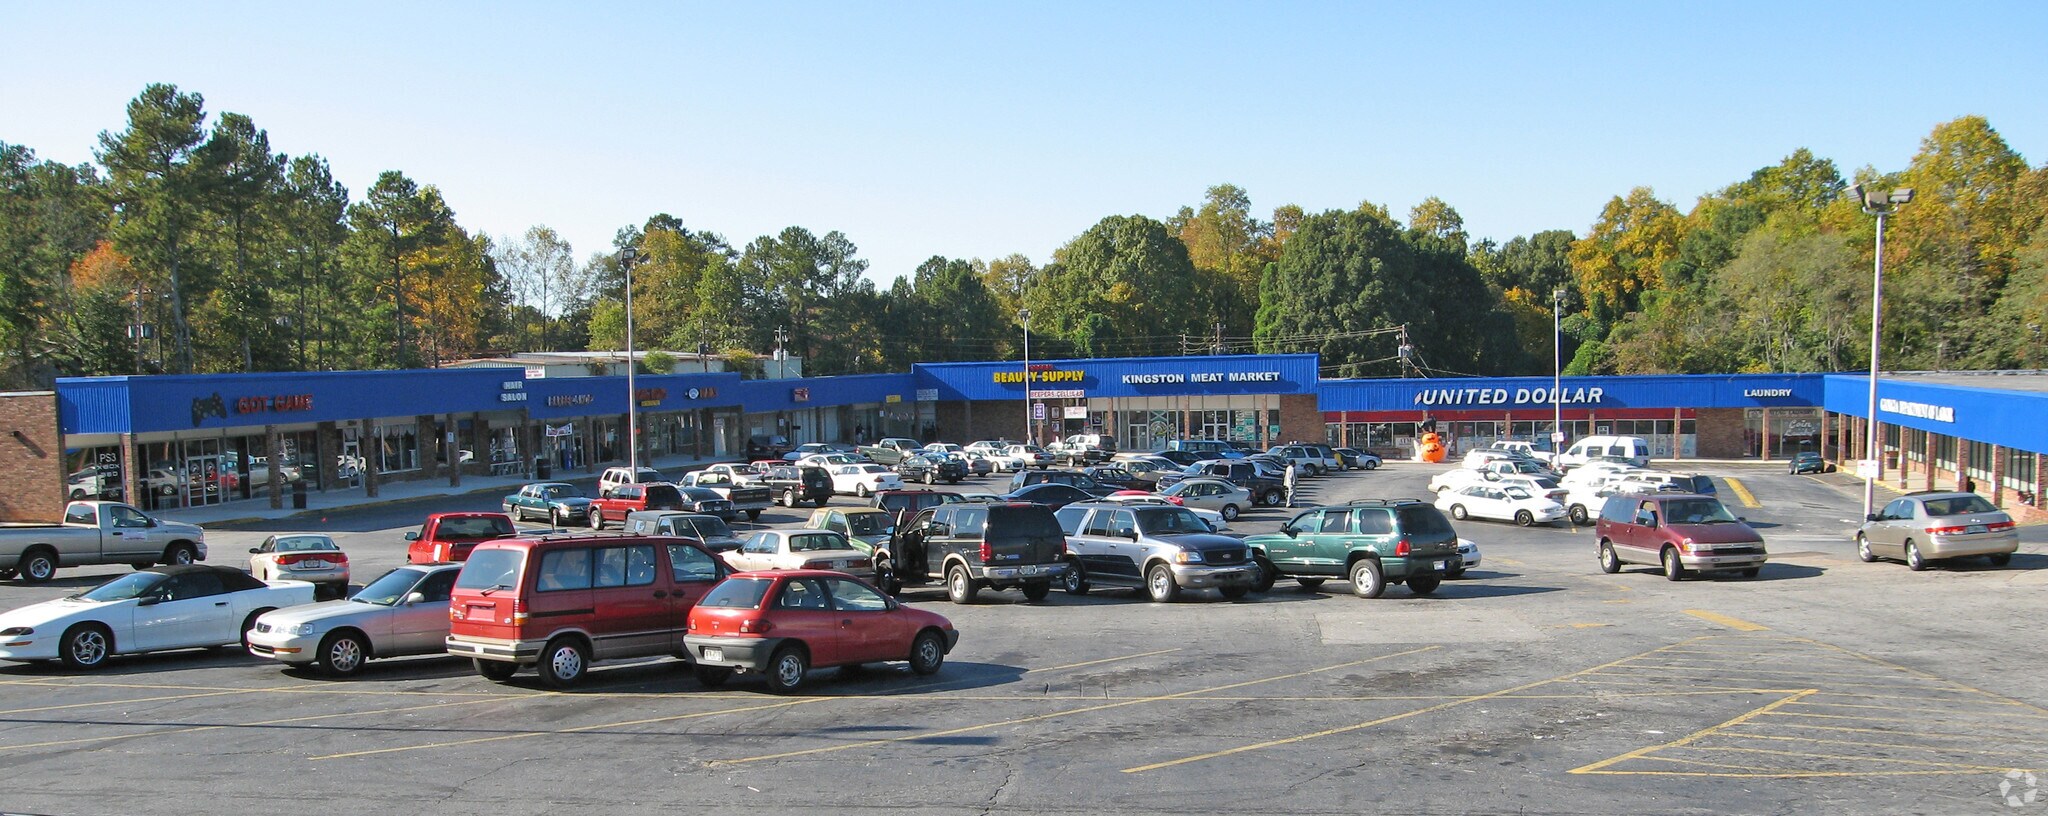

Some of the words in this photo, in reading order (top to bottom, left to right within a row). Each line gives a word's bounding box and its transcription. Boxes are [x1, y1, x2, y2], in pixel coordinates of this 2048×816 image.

[1041, 370, 1085, 382] SUPPLY
[1122, 374, 1184, 383] KINGSTON
[1191, 373, 1224, 382] MEAT
[1229, 372, 1280, 381] MARKET
[503, 381, 523, 390] HAIR
[500, 393, 527, 402] SALON
[1422, 388, 1508, 405] UNITED
[1514, 387, 1604, 404] DOLLAR
[1744, 389, 1792, 397] LAUNDRY
[238, 396, 269, 414] GOT
[274, 394, 314, 412] GAME
[1788, 419, 1812, 429] Coin
[99, 452, 117, 463] PS3
